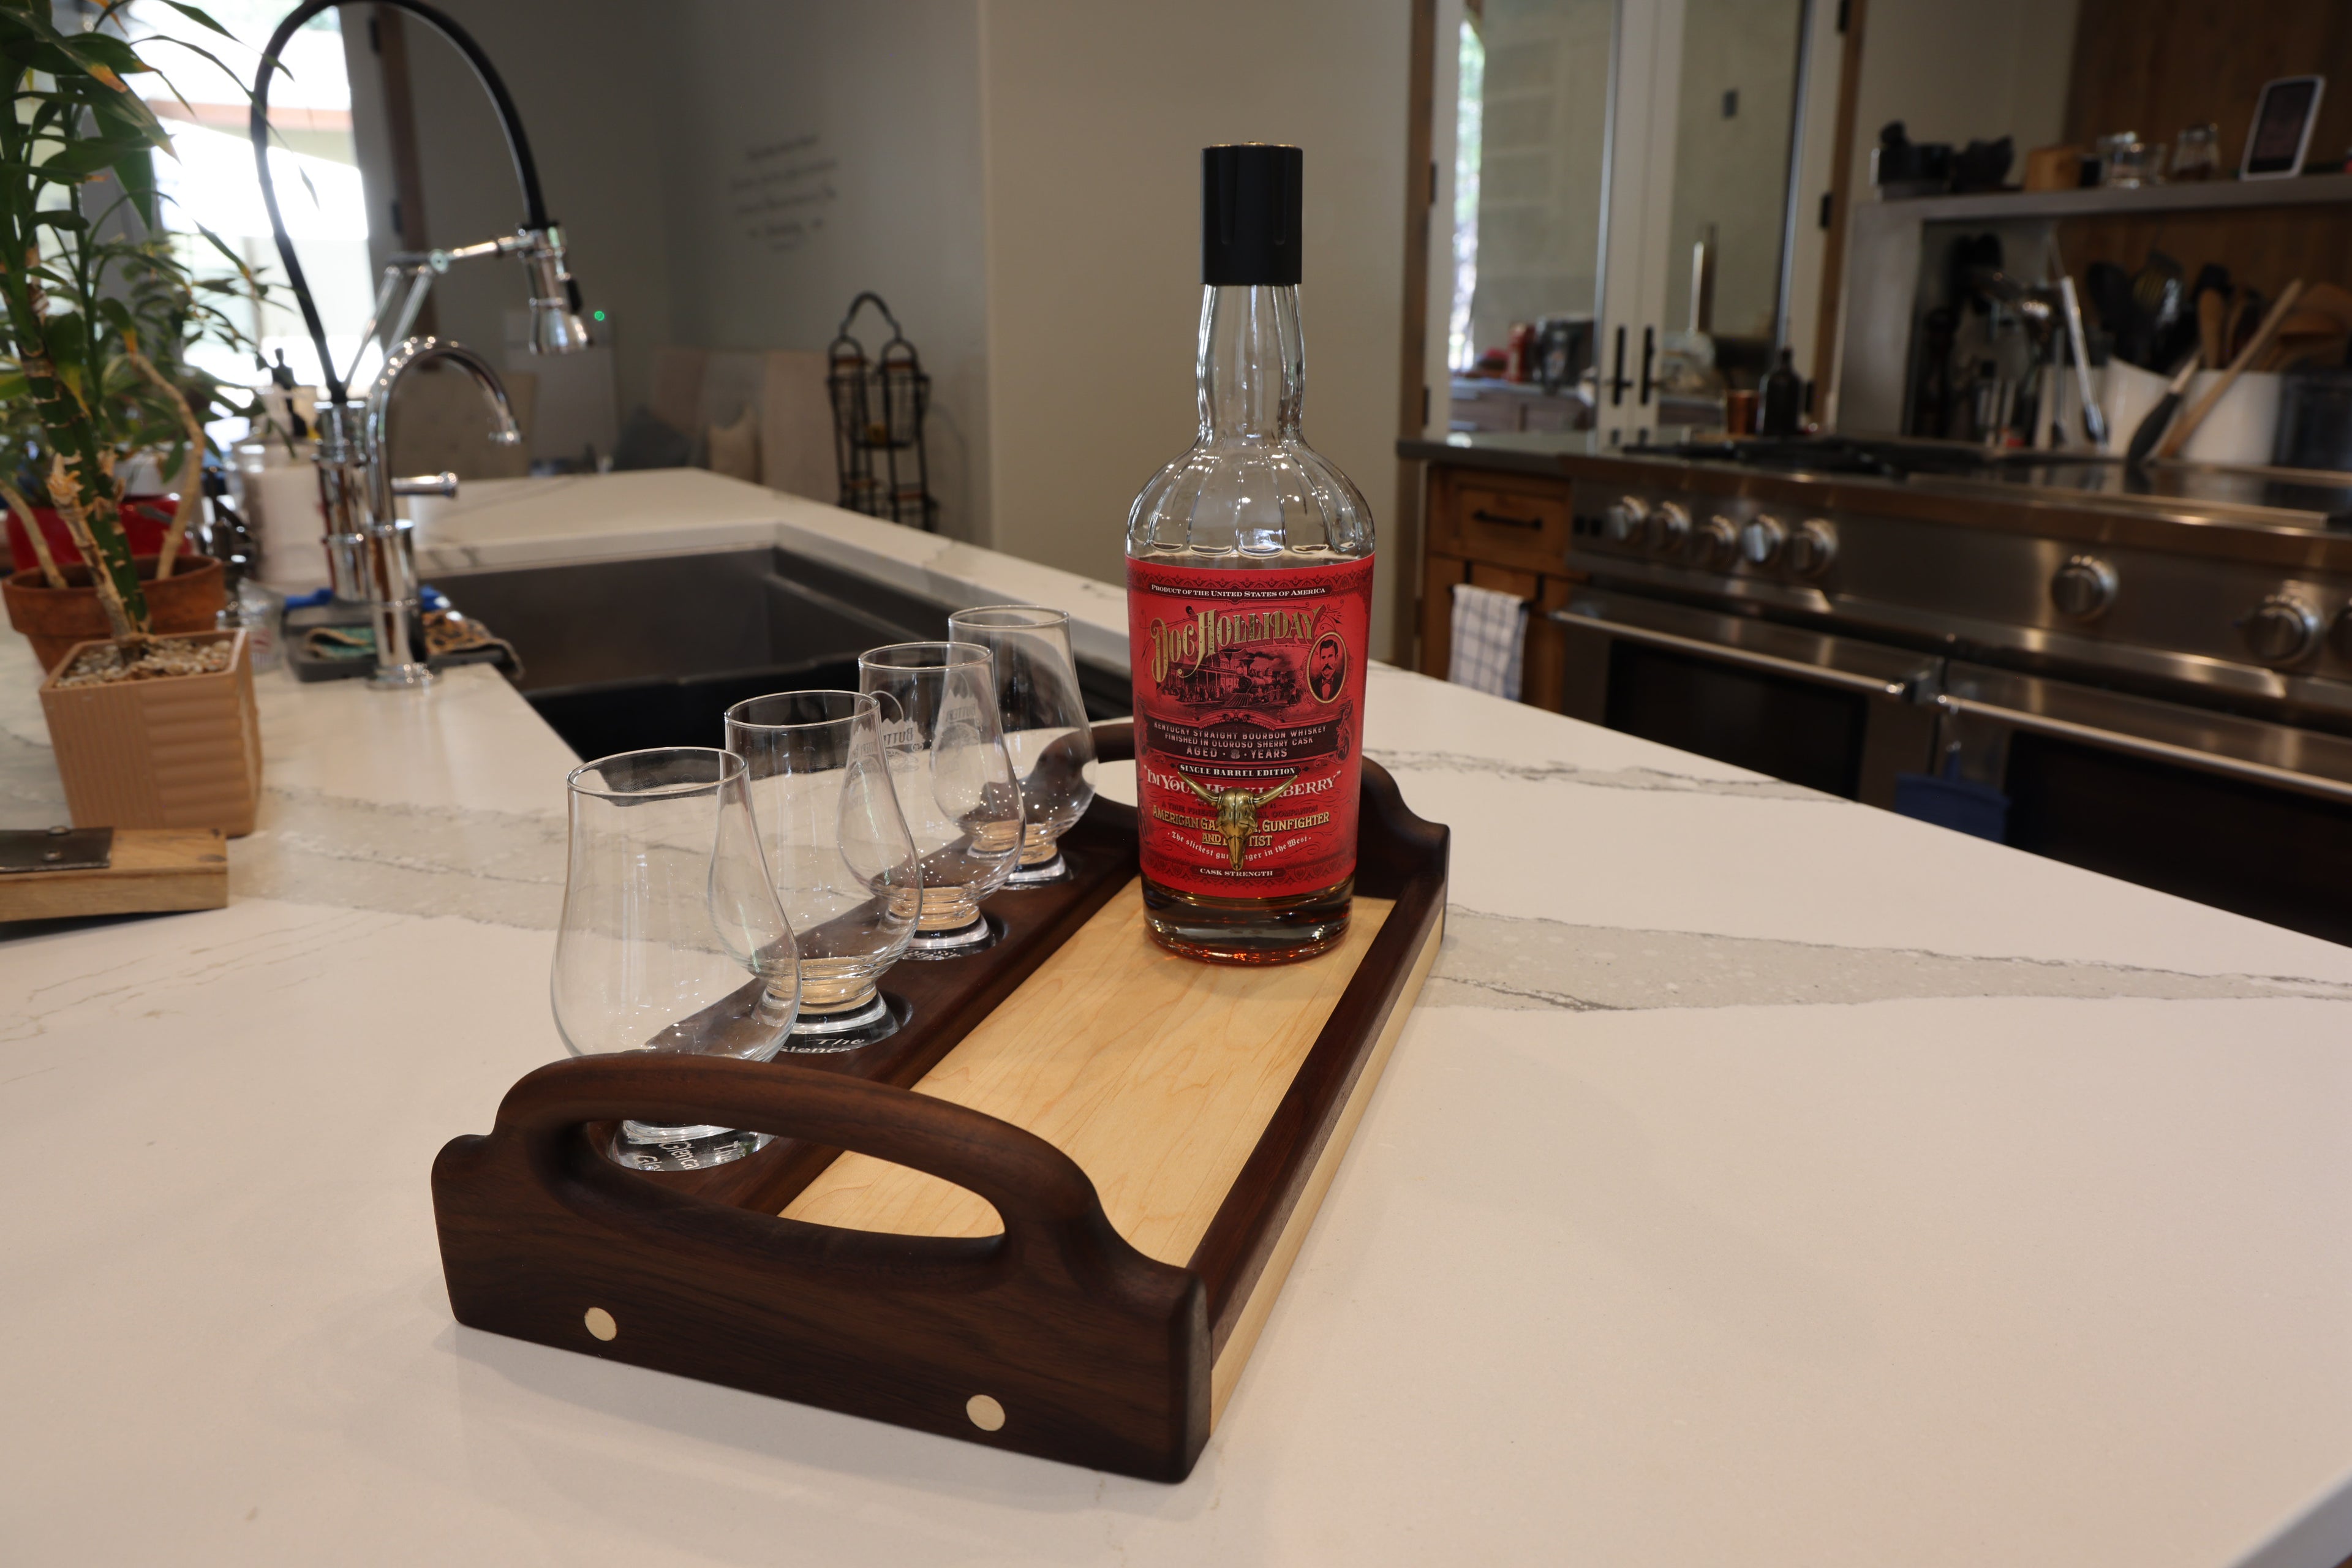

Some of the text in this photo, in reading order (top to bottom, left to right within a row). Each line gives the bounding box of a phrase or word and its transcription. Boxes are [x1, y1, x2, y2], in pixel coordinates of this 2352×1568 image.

[1152, 584, 1182, 594] PRODUCT
[1150, 604, 1324, 683] DOC HOLLIDAY
[1154, 722, 1189, 735] KENTUCKY
[1193, 730, 1237, 739] STRAIGHT
[1290, 725, 1326, 737] WHISKEY
[1165, 733, 1198, 744] FINISHED
[1292, 736, 1313, 745] CASK
[1186, 745, 1287, 759] AGED 8 YEARS
[1180, 764, 1212, 774] SINGLE
[1257, 767, 1295, 776] EDITION
[1272, 804, 1318, 818] COMPANION
[1153, 805, 1200, 829] AMERICAN
[1262, 812, 1330, 832] GUNFIGHTER
[1172, 831, 1184, 842] The
[1186, 839, 1214, 856] slickest
[1275, 843, 1287, 854] the
[1287, 835, 1308, 848] West
[1202, 832, 1221, 845] AND
